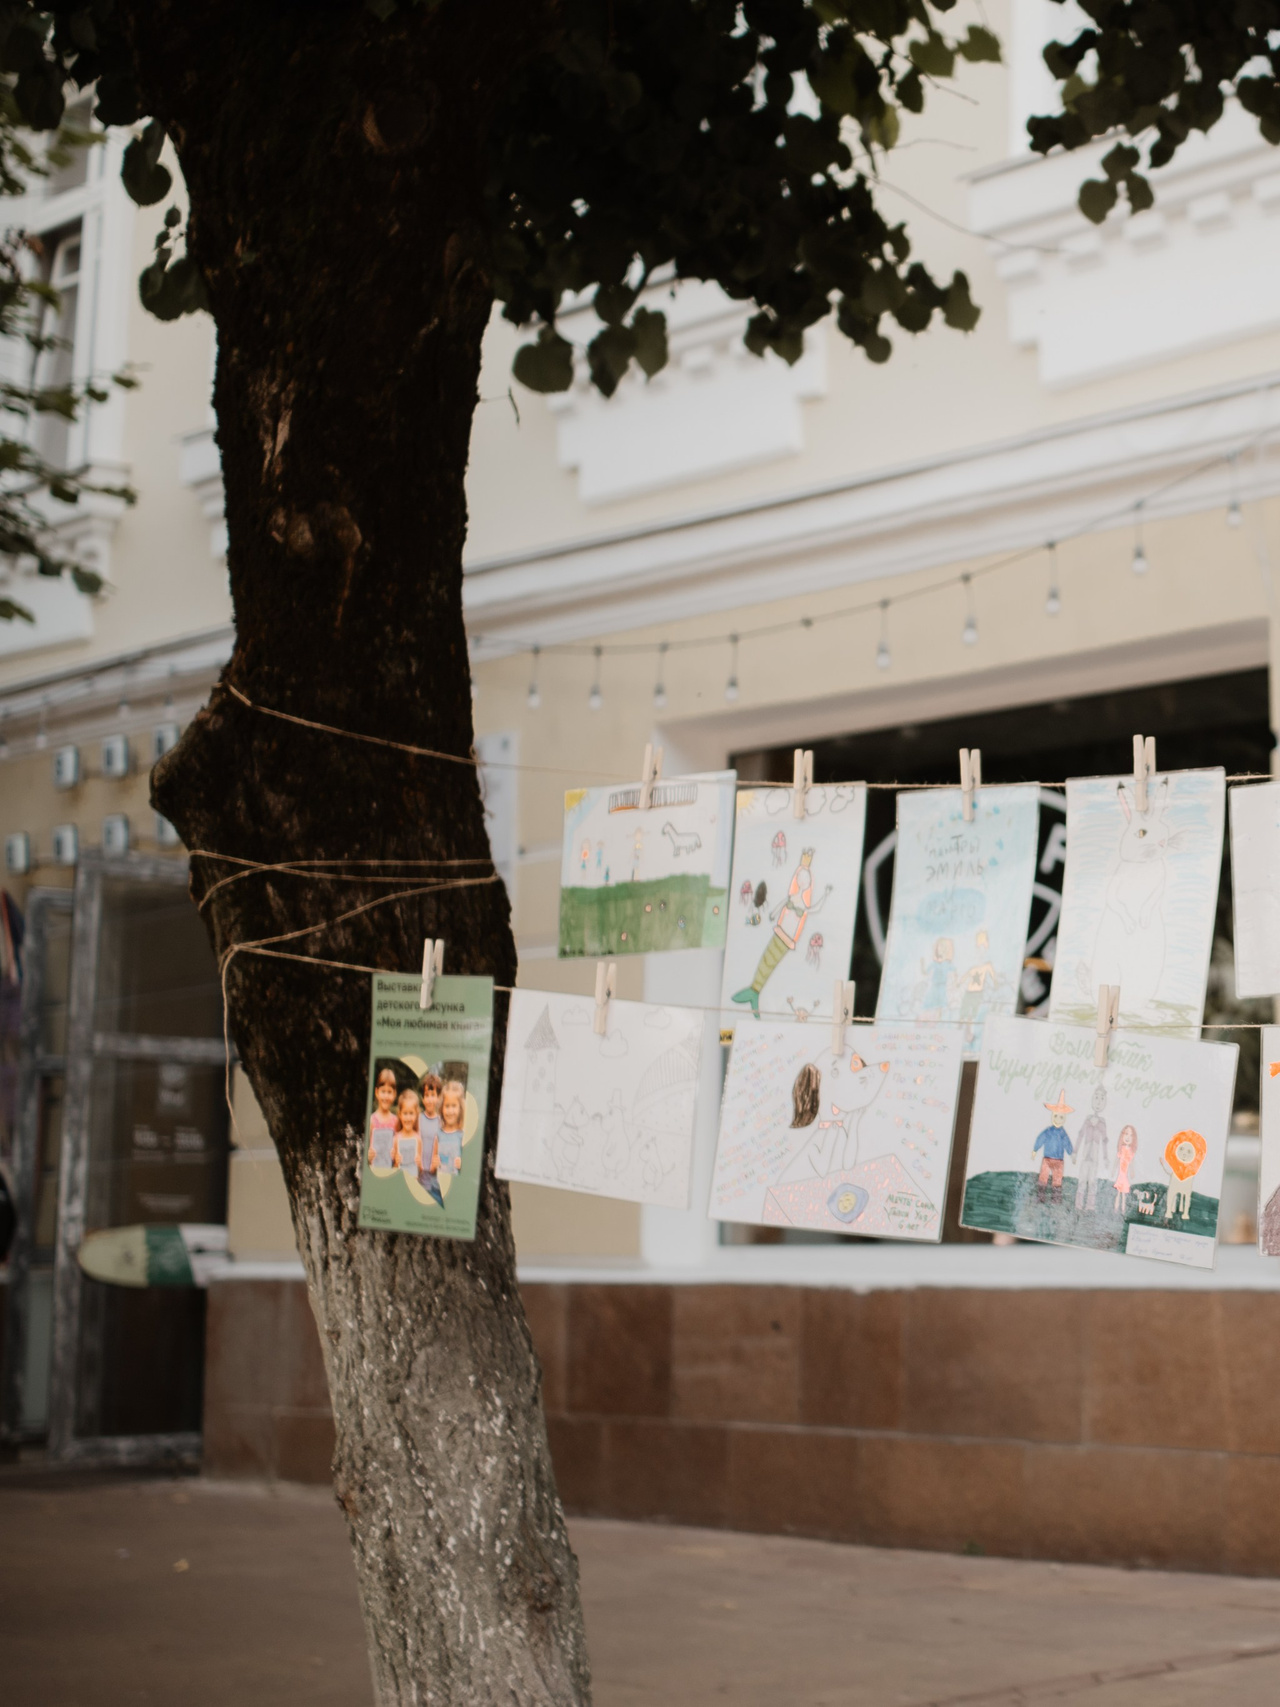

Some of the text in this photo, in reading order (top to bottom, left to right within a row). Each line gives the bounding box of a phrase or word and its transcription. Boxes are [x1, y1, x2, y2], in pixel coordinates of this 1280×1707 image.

[376, 999, 420, 1012] детского
[376, 1016, 402, 1030] «Моя
[403, 1017, 448, 1031] любимая
